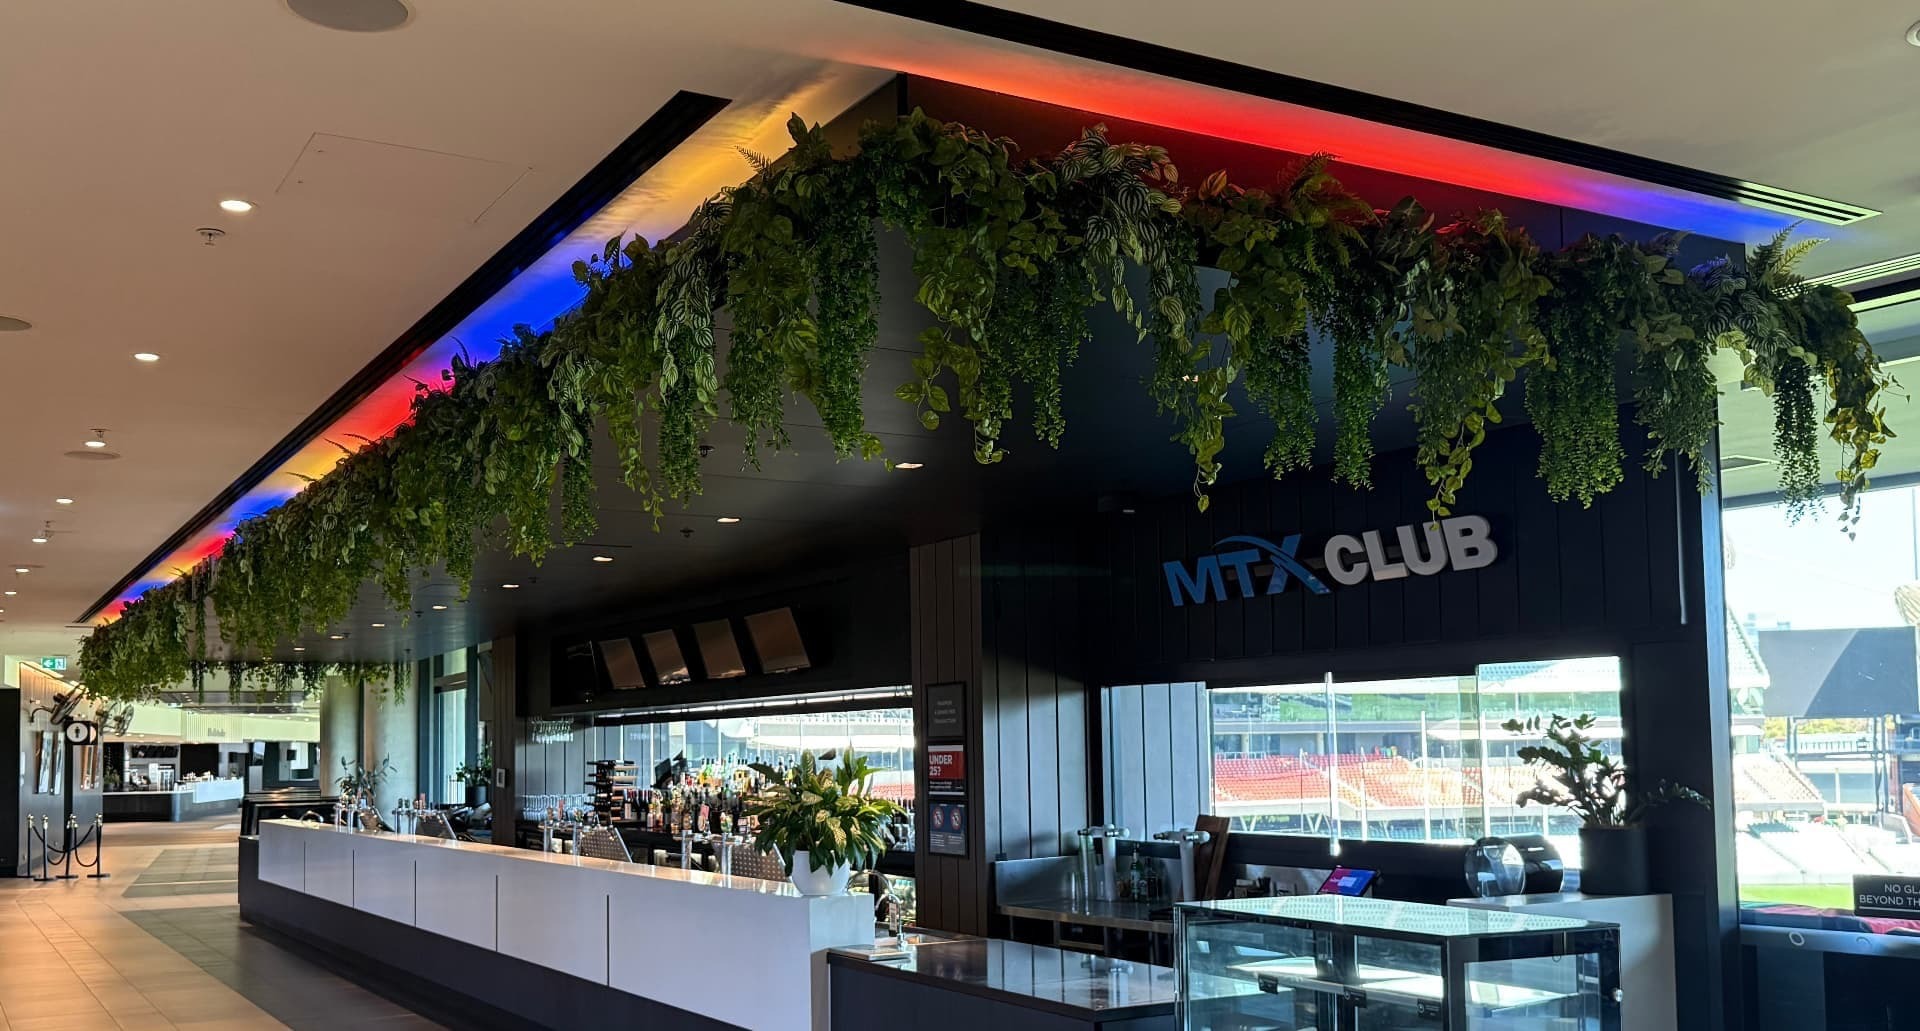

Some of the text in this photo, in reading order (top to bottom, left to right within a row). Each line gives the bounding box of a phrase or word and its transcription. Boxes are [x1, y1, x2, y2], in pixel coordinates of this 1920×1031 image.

[1162, 515, 1498, 607] MTX CLUB
[929, 754, 952, 765] UNDER
[929, 766, 941, 776] 25?
[1884, 883, 1920, 894] NO GL
[1859, 894, 1904, 905] BEYOND
